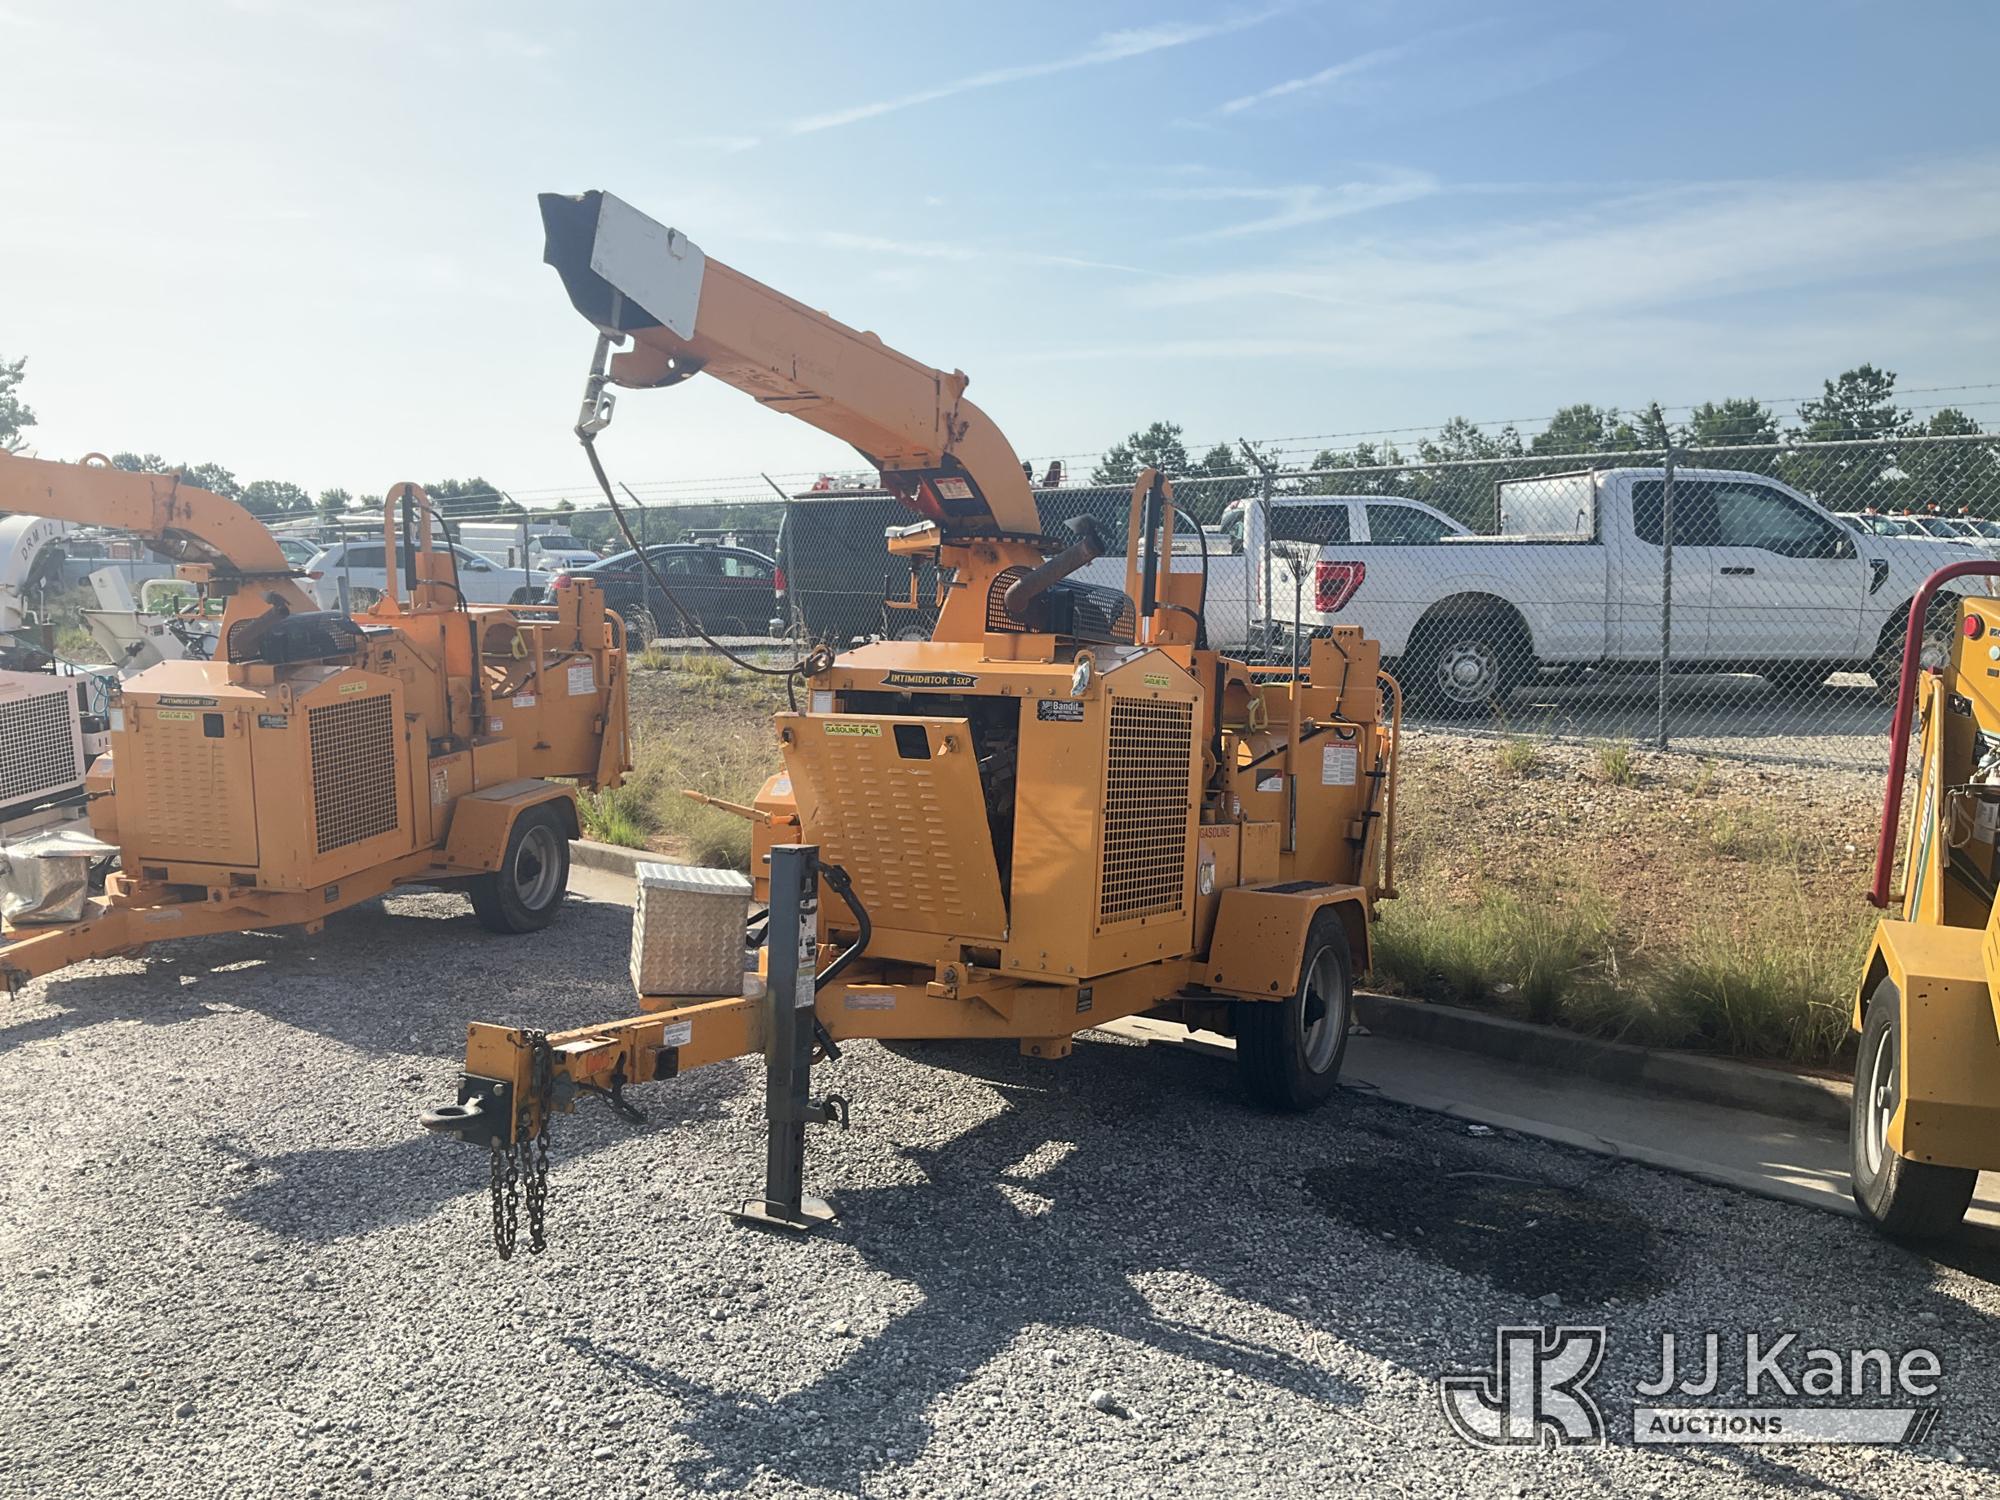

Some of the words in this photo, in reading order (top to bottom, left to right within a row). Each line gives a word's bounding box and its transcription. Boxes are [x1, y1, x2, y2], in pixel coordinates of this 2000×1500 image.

[891, 674, 948, 685] INTIMIDATOR
[952, 677, 971, 686] 15XP
[1053, 701, 1079, 711] Bandit
[825, 726, 860, 734] GASOLINE
[861, 727, 879, 735] ONLY
[1200, 826, 1230, 838] GASOLINE
